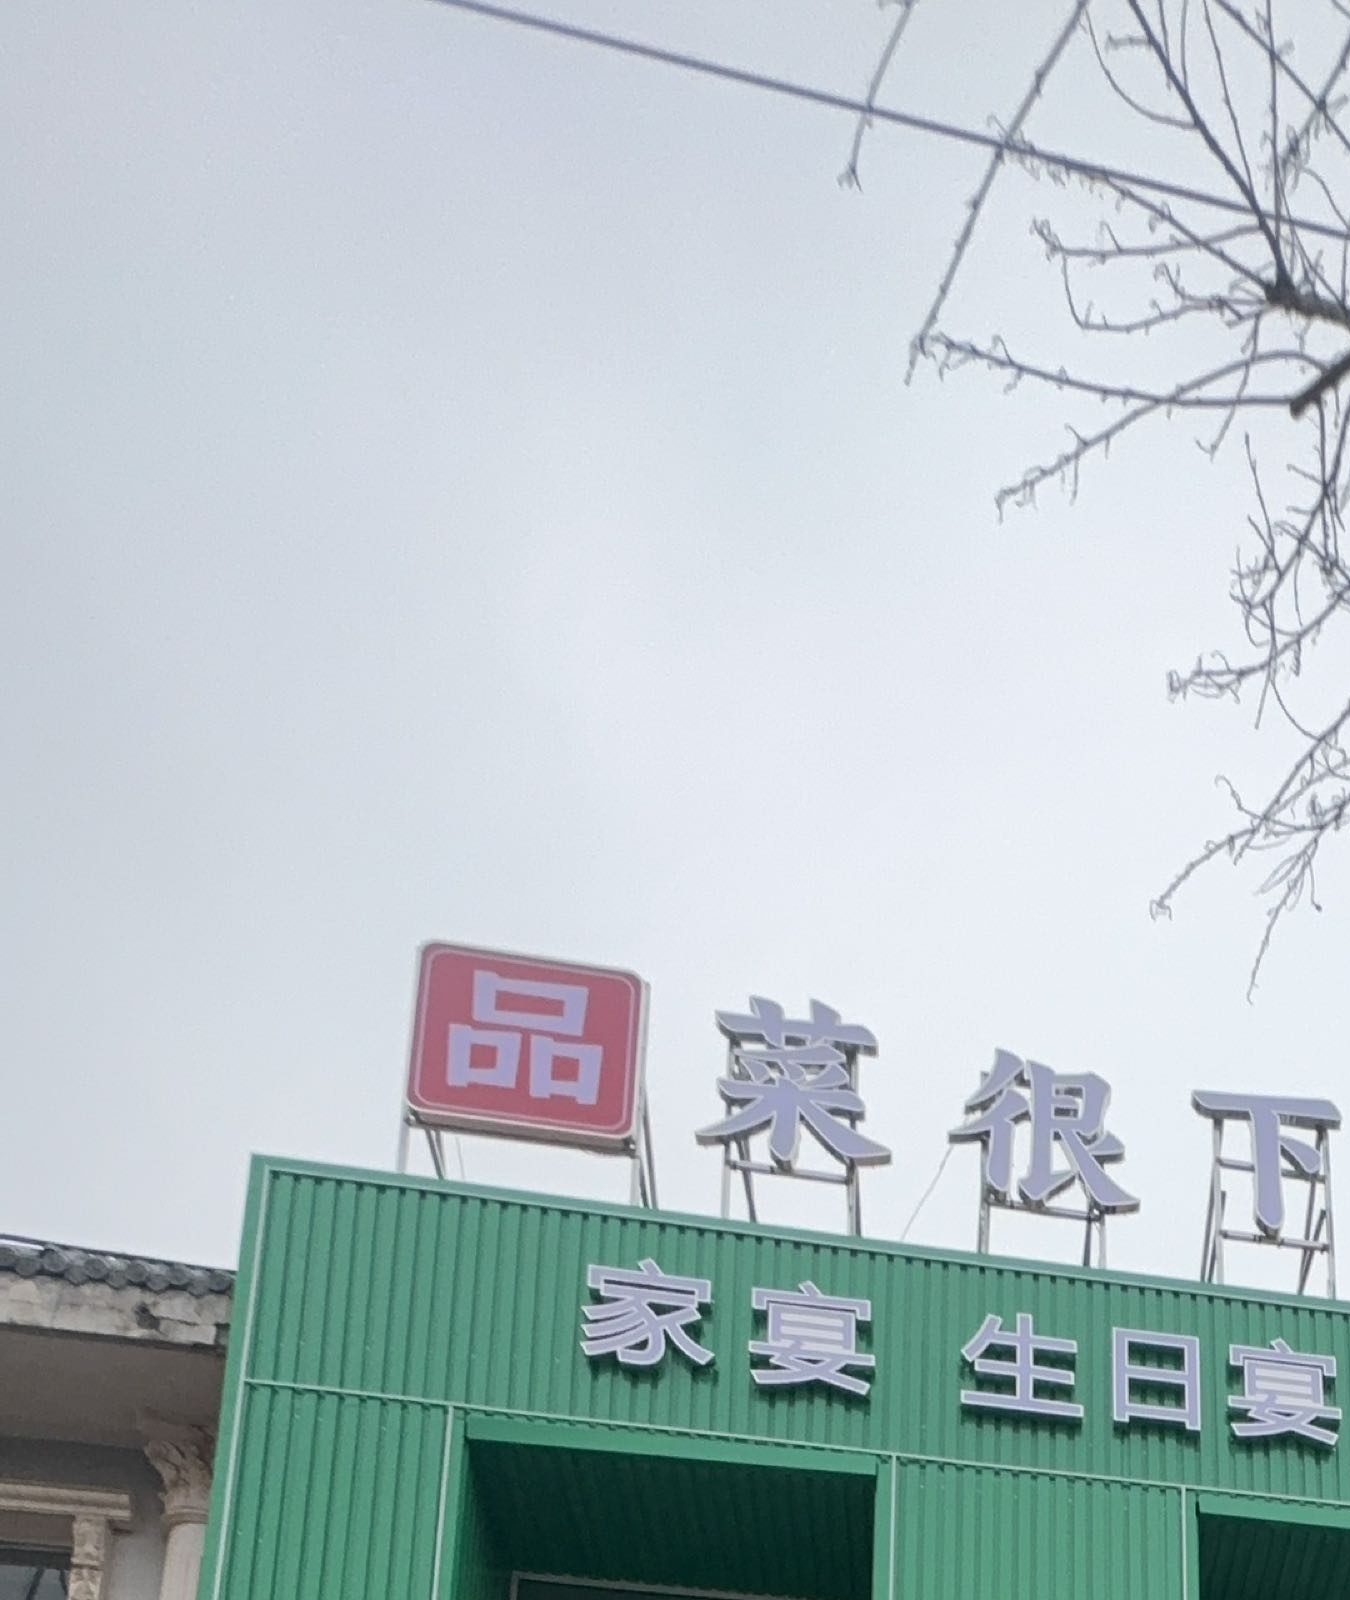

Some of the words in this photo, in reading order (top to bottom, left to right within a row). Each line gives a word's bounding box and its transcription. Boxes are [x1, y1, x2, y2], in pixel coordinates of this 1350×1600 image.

[446, 969, 602, 1107] 品
[580, 1257, 877, 1396] 家宴
[960, 1312, 1342, 1447] 生日宴
